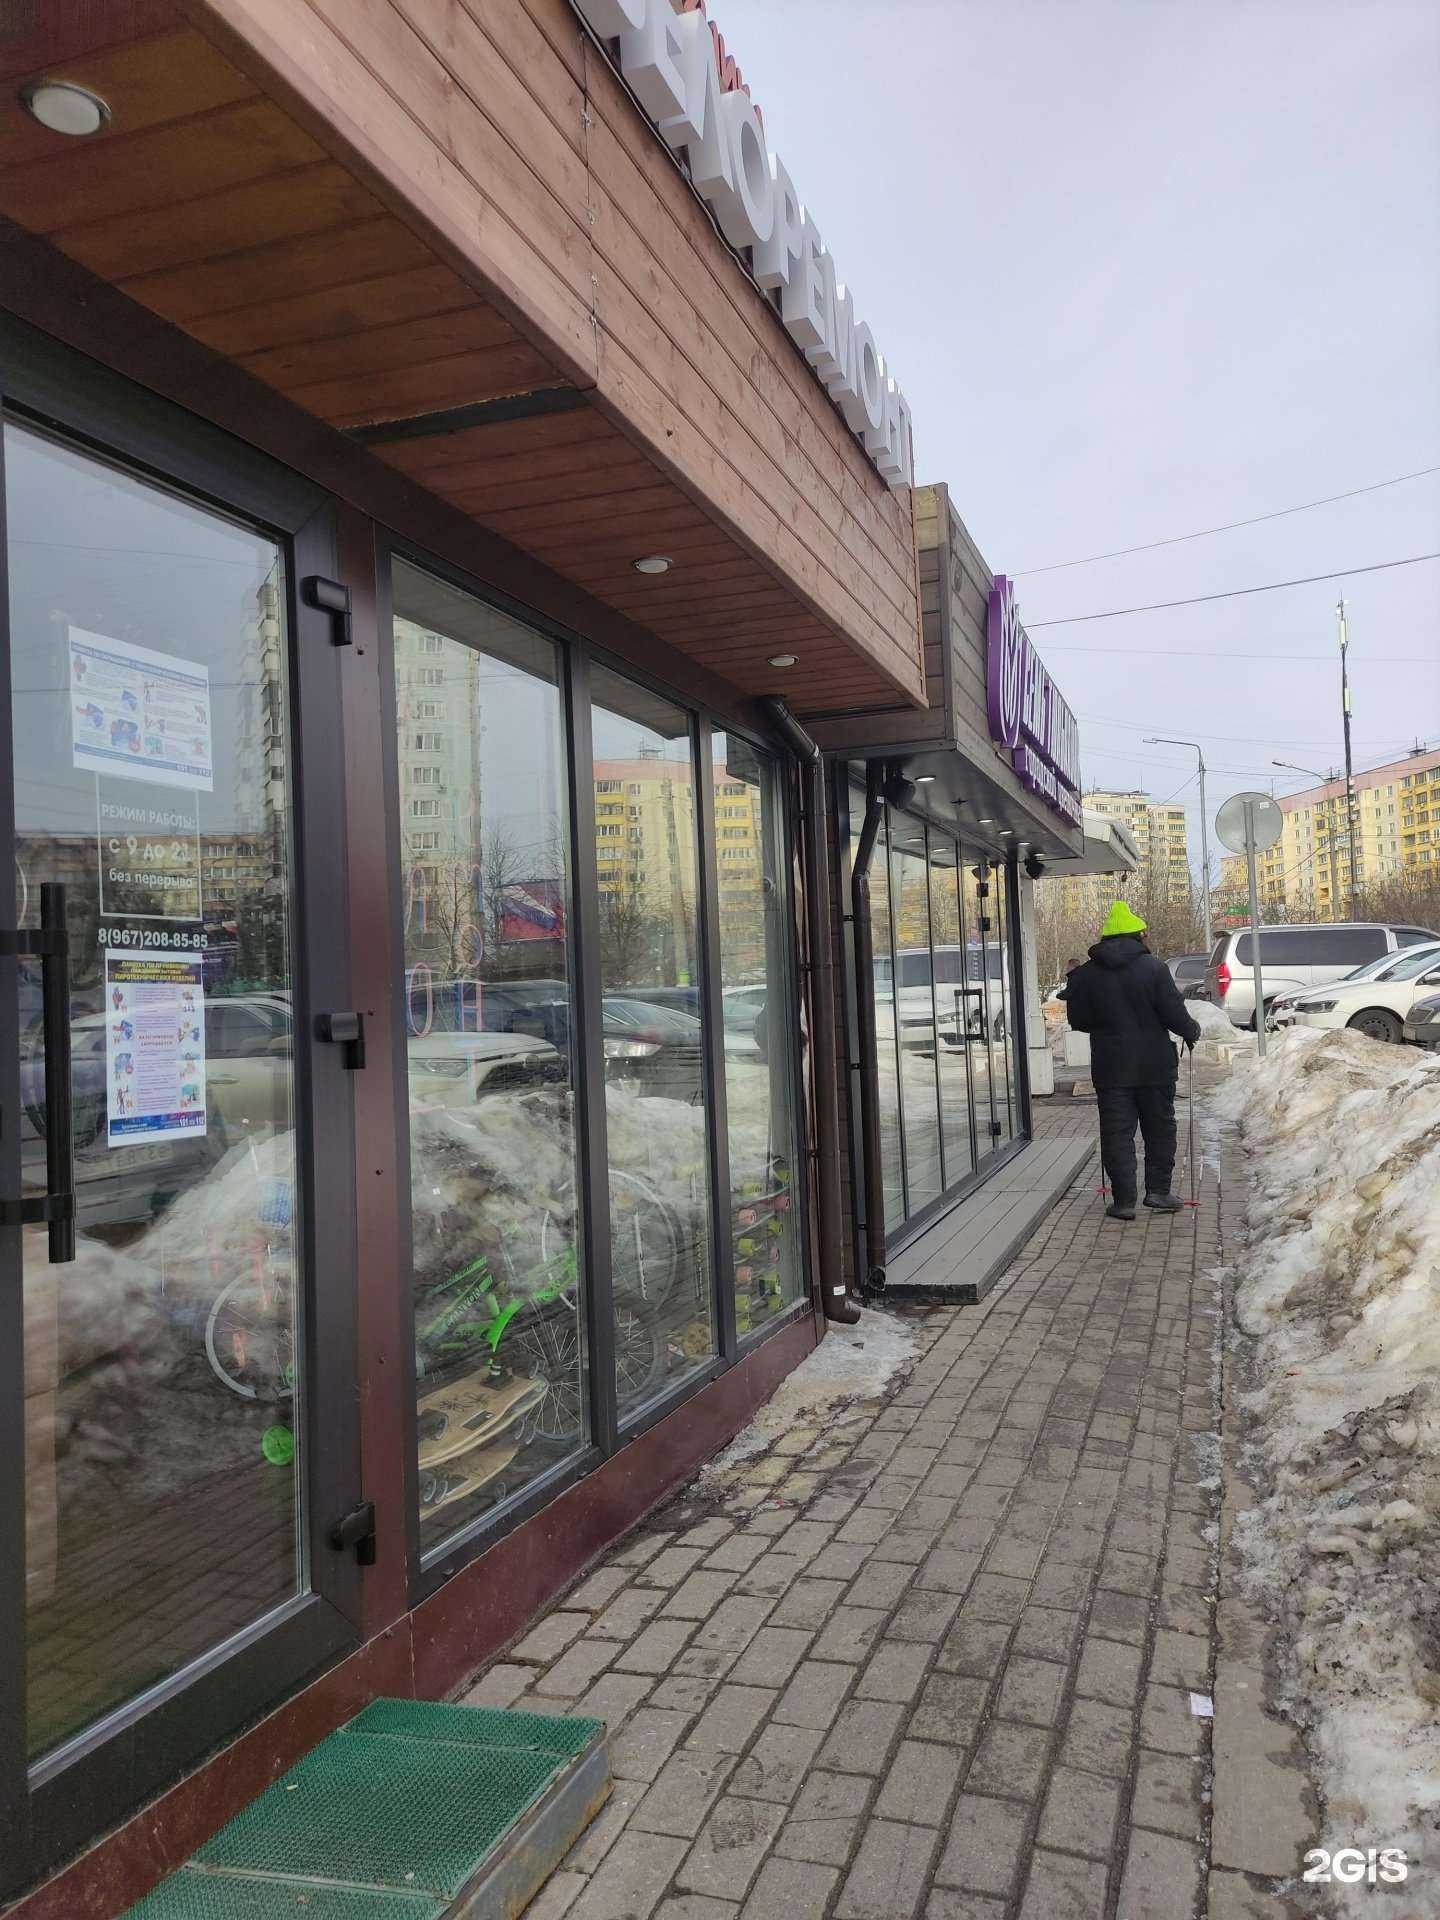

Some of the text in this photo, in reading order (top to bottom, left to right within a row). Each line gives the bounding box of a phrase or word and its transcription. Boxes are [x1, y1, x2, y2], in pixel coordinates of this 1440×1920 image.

[101, 803, 146, 822] РЕЖИМ
[126, 834, 138, 855] 9
[143, 843, 165, 862] до
[170, 841, 192, 862] 21
[109, 867, 132, 882] без
[97, 927, 209, 950] 8(967)208-85-85
